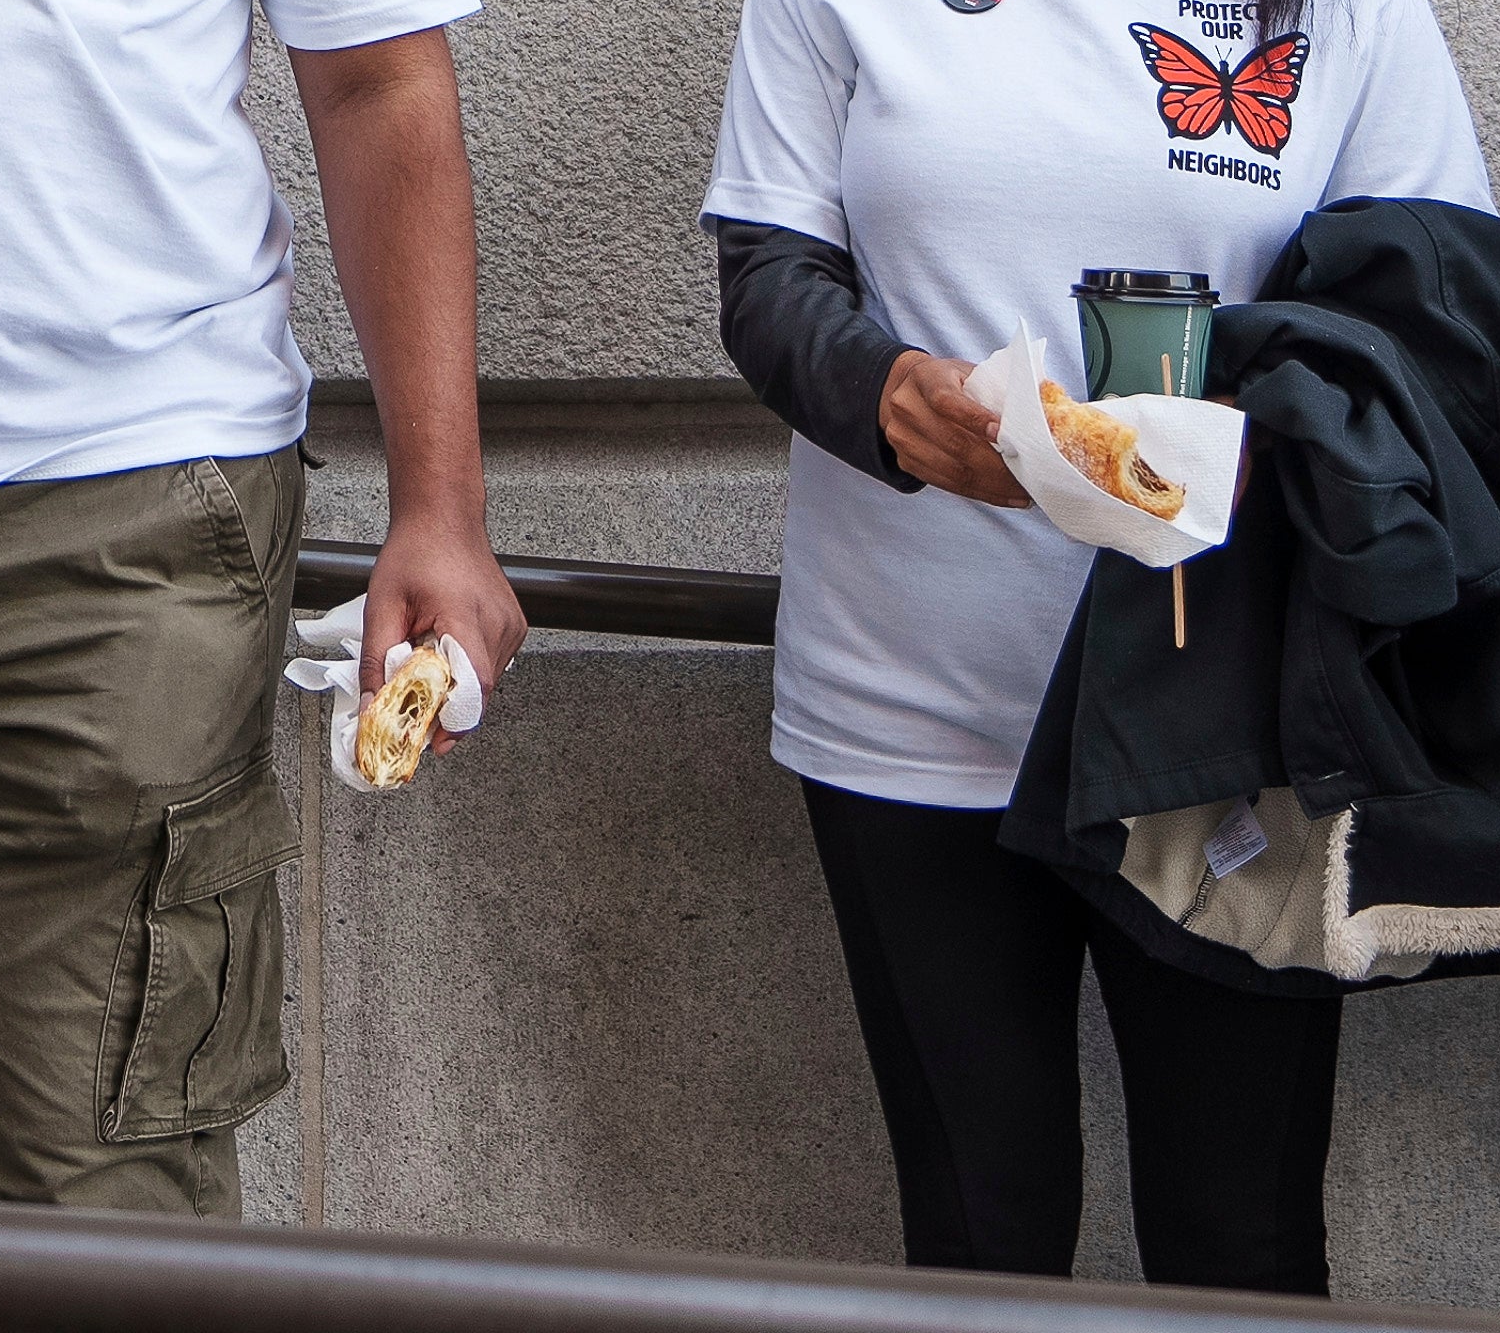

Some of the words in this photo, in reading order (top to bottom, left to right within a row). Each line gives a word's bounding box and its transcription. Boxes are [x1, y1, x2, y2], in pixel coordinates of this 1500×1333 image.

[1178, 0, 1260, 21] PROTEC
[1201, 21, 1244, 40] OUR
[1168, 148, 1282, 191] NEIGHBORS
